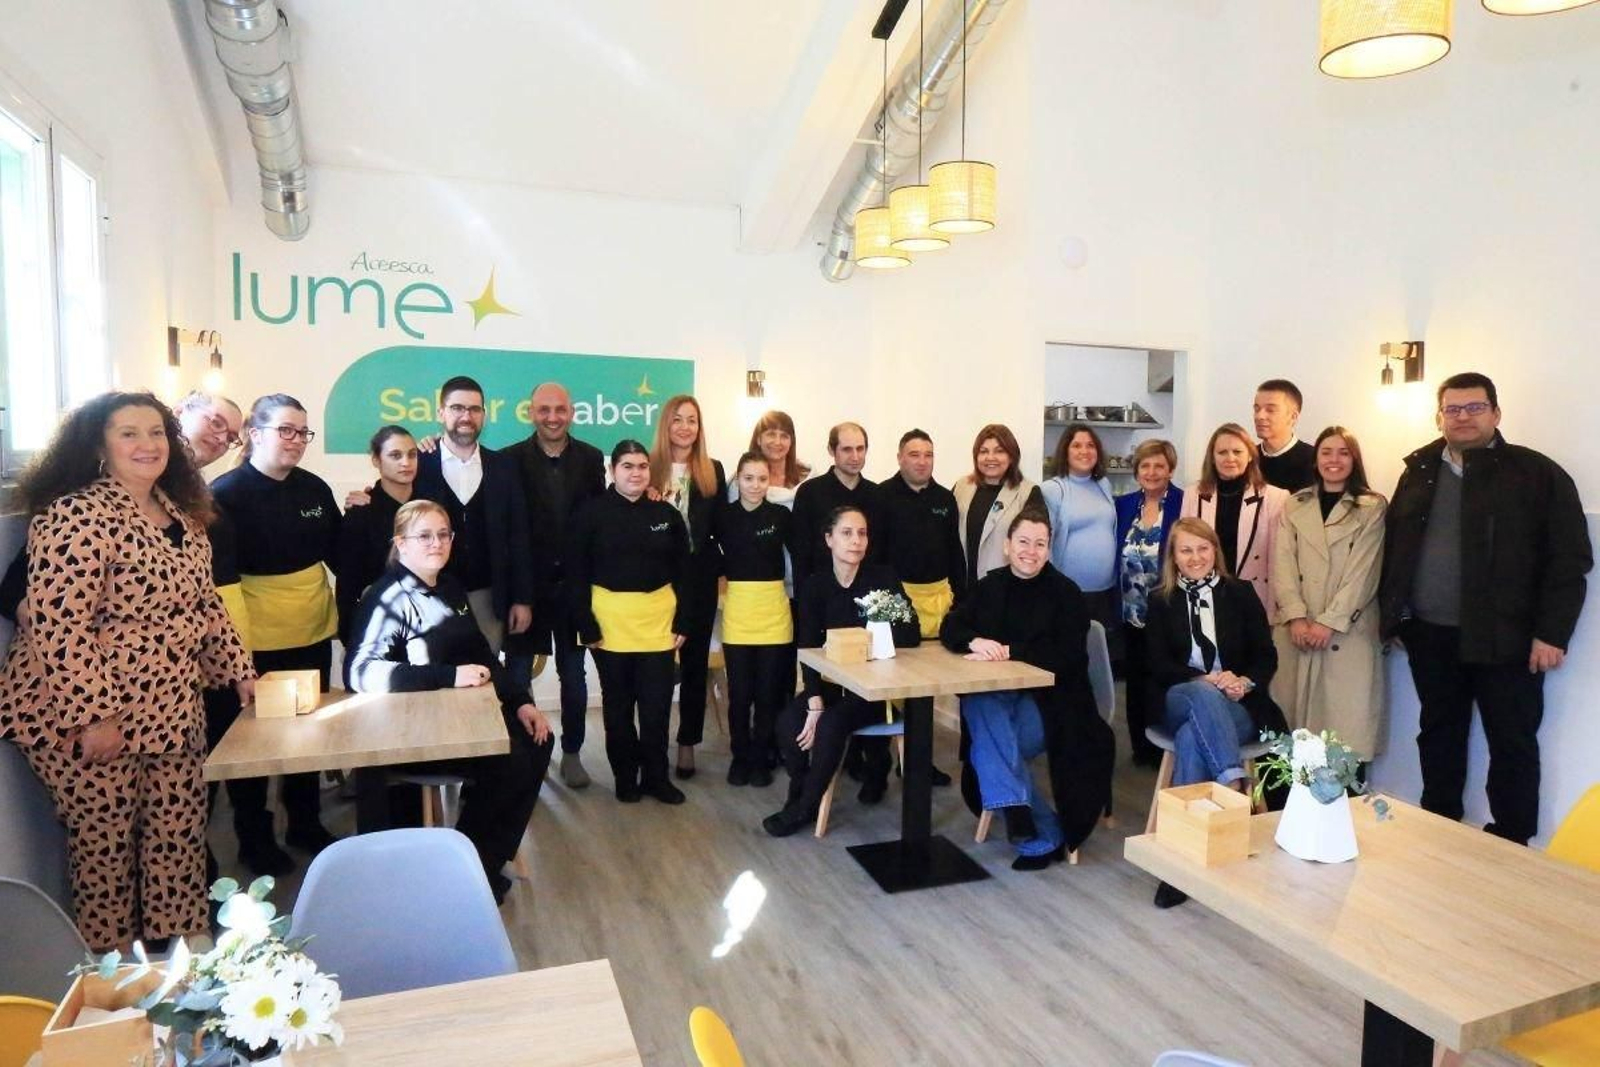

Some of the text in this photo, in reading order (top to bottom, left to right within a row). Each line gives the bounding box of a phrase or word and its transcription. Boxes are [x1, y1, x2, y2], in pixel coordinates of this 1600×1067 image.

[351, 251, 435, 275] Aceesca
[233, 252, 454, 340] lume
[380, 388, 505, 423] Sar
[572, 394, 659, 426] aber
